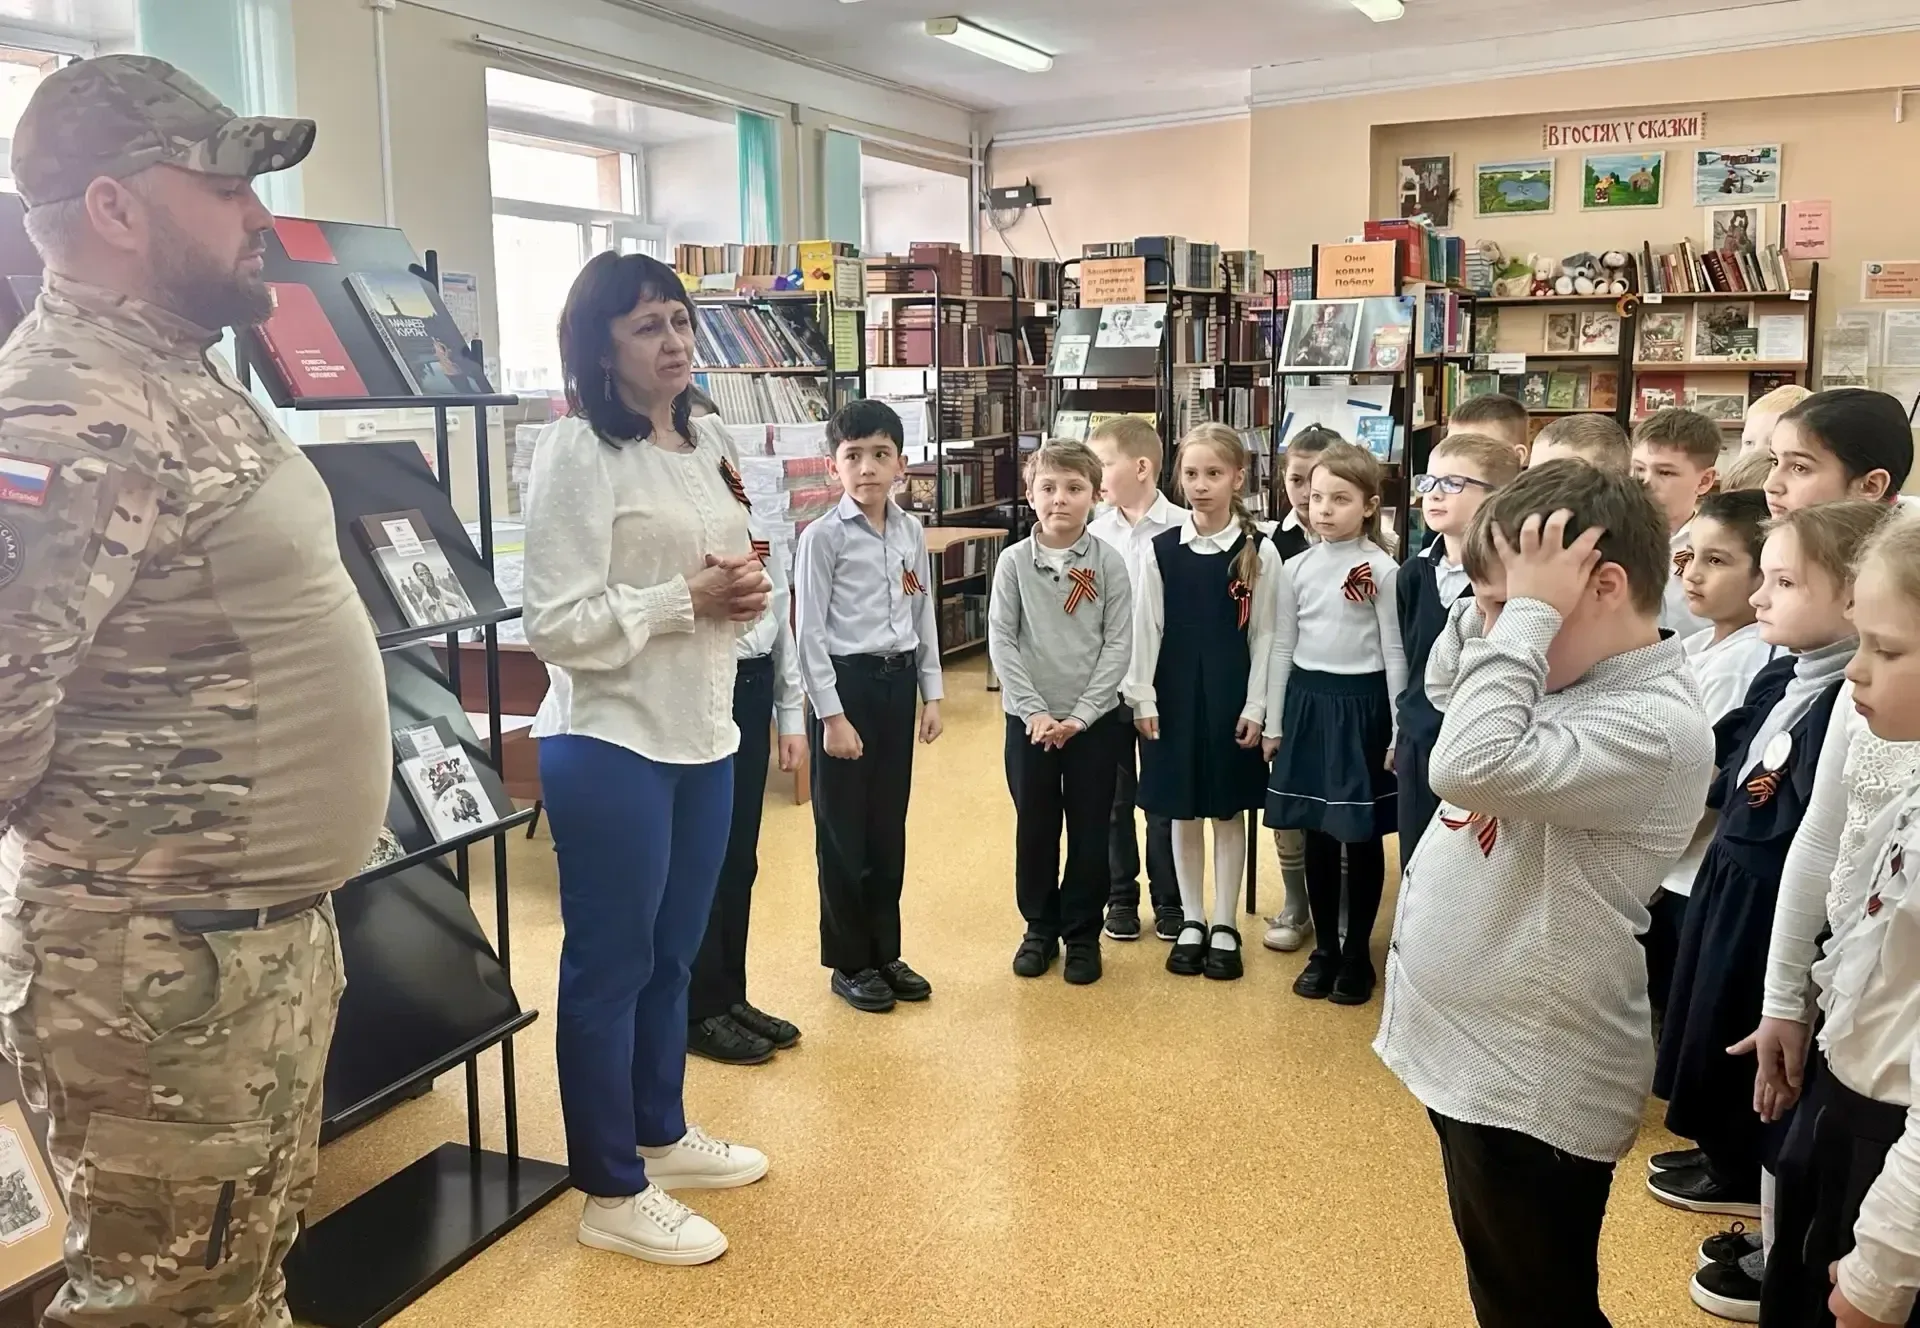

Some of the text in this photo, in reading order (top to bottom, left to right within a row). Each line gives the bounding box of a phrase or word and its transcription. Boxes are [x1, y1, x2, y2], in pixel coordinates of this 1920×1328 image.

[1549, 117, 1698, 146] В ГОСТЯХ У СКАЗКИ
[1344, 255, 1366, 263] Они
[1335, 267, 1374, 276] ковали
[1335, 278, 1374, 287] Победу
[388, 318, 425, 328] МАМАЕВ
[395, 327, 428, 337] КУРГАН
[0, 525, 17, 559] СКАЯ
